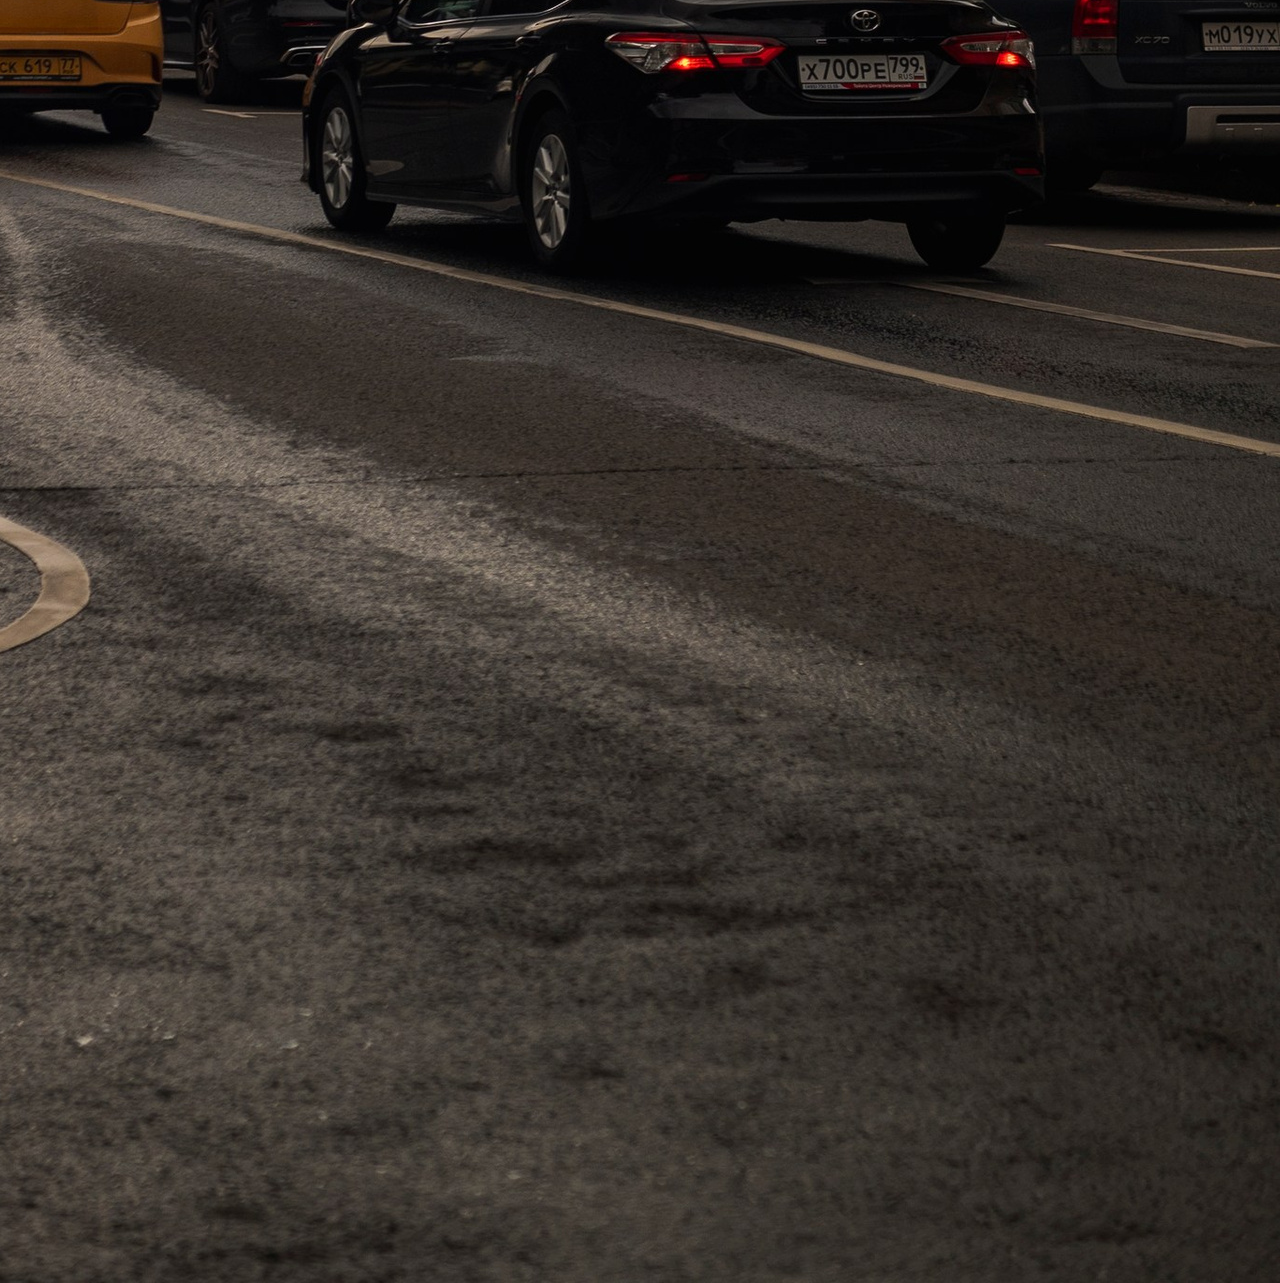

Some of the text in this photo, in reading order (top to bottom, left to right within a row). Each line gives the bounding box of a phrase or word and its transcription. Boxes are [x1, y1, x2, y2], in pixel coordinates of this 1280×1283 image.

[1245, 1, 1278, 9] VOLVO
[1134, 36, 1171, 44] XC70
[23, 58, 52, 74] 619
[60, 58, 75, 70] 77
[889, 56, 920, 73] 799
